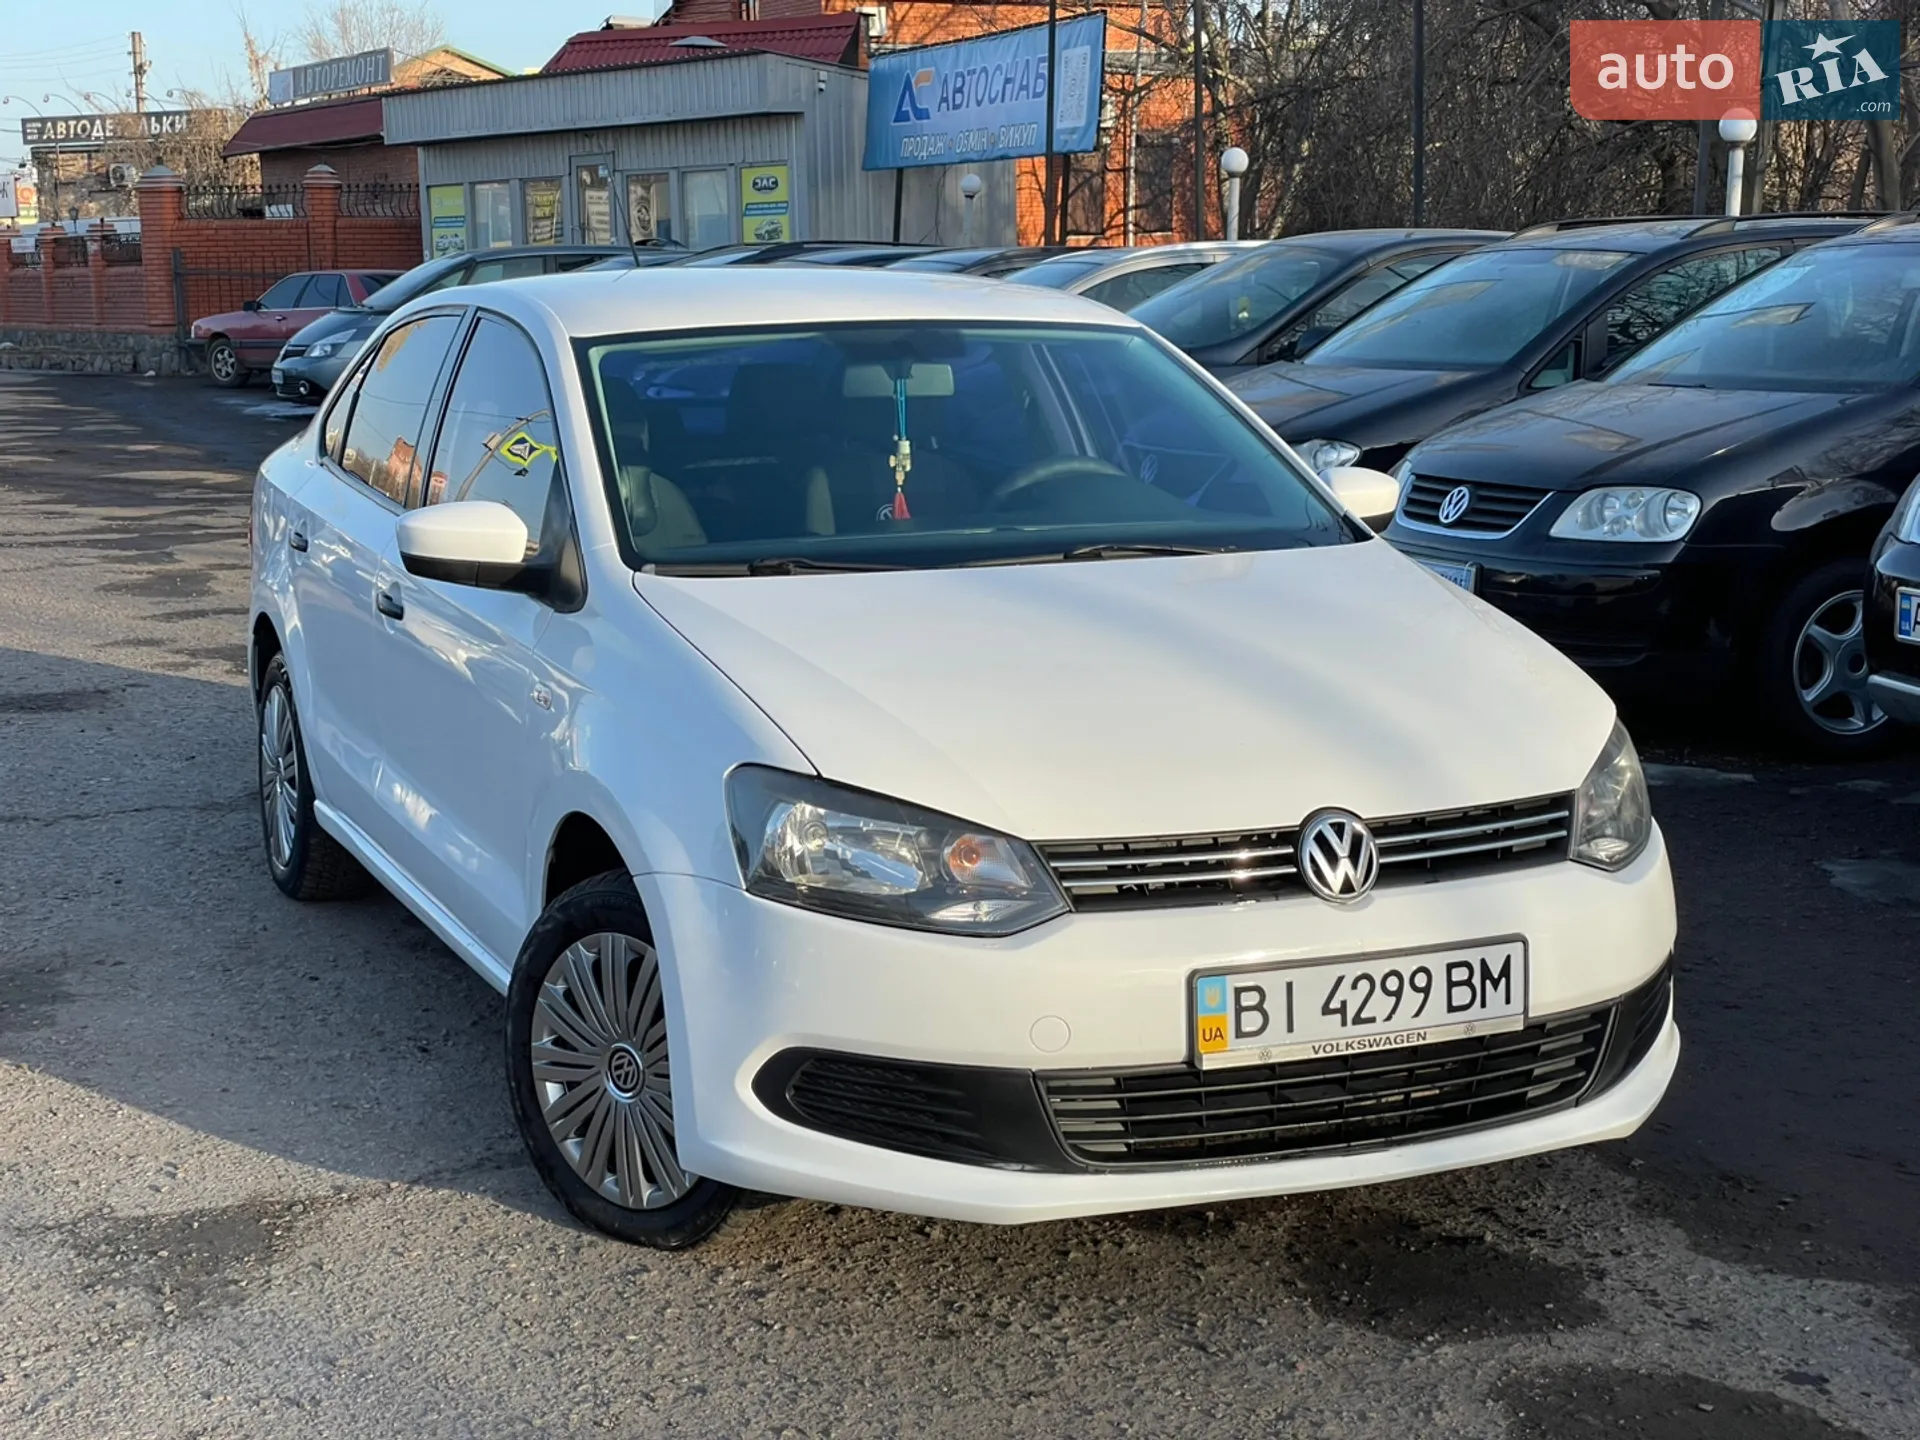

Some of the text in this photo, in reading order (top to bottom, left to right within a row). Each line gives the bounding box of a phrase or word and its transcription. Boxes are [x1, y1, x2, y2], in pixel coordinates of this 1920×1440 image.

[298, 54, 385, 95] АВТОРЕМОНТ
[937, 54, 1048, 112] АВТОСНАБ
[43, 113, 188, 140] АВТОДЕЛЬКИ
[901, 122, 1038, 160] ПРОДАЖ ОБМІН ВИКУП
[1233, 953, 1512, 1040] BI 4299 BM
[1202, 1026, 1225, 1043] UA
[1311, 1031, 1428, 1056] VOLKSWAGEN
